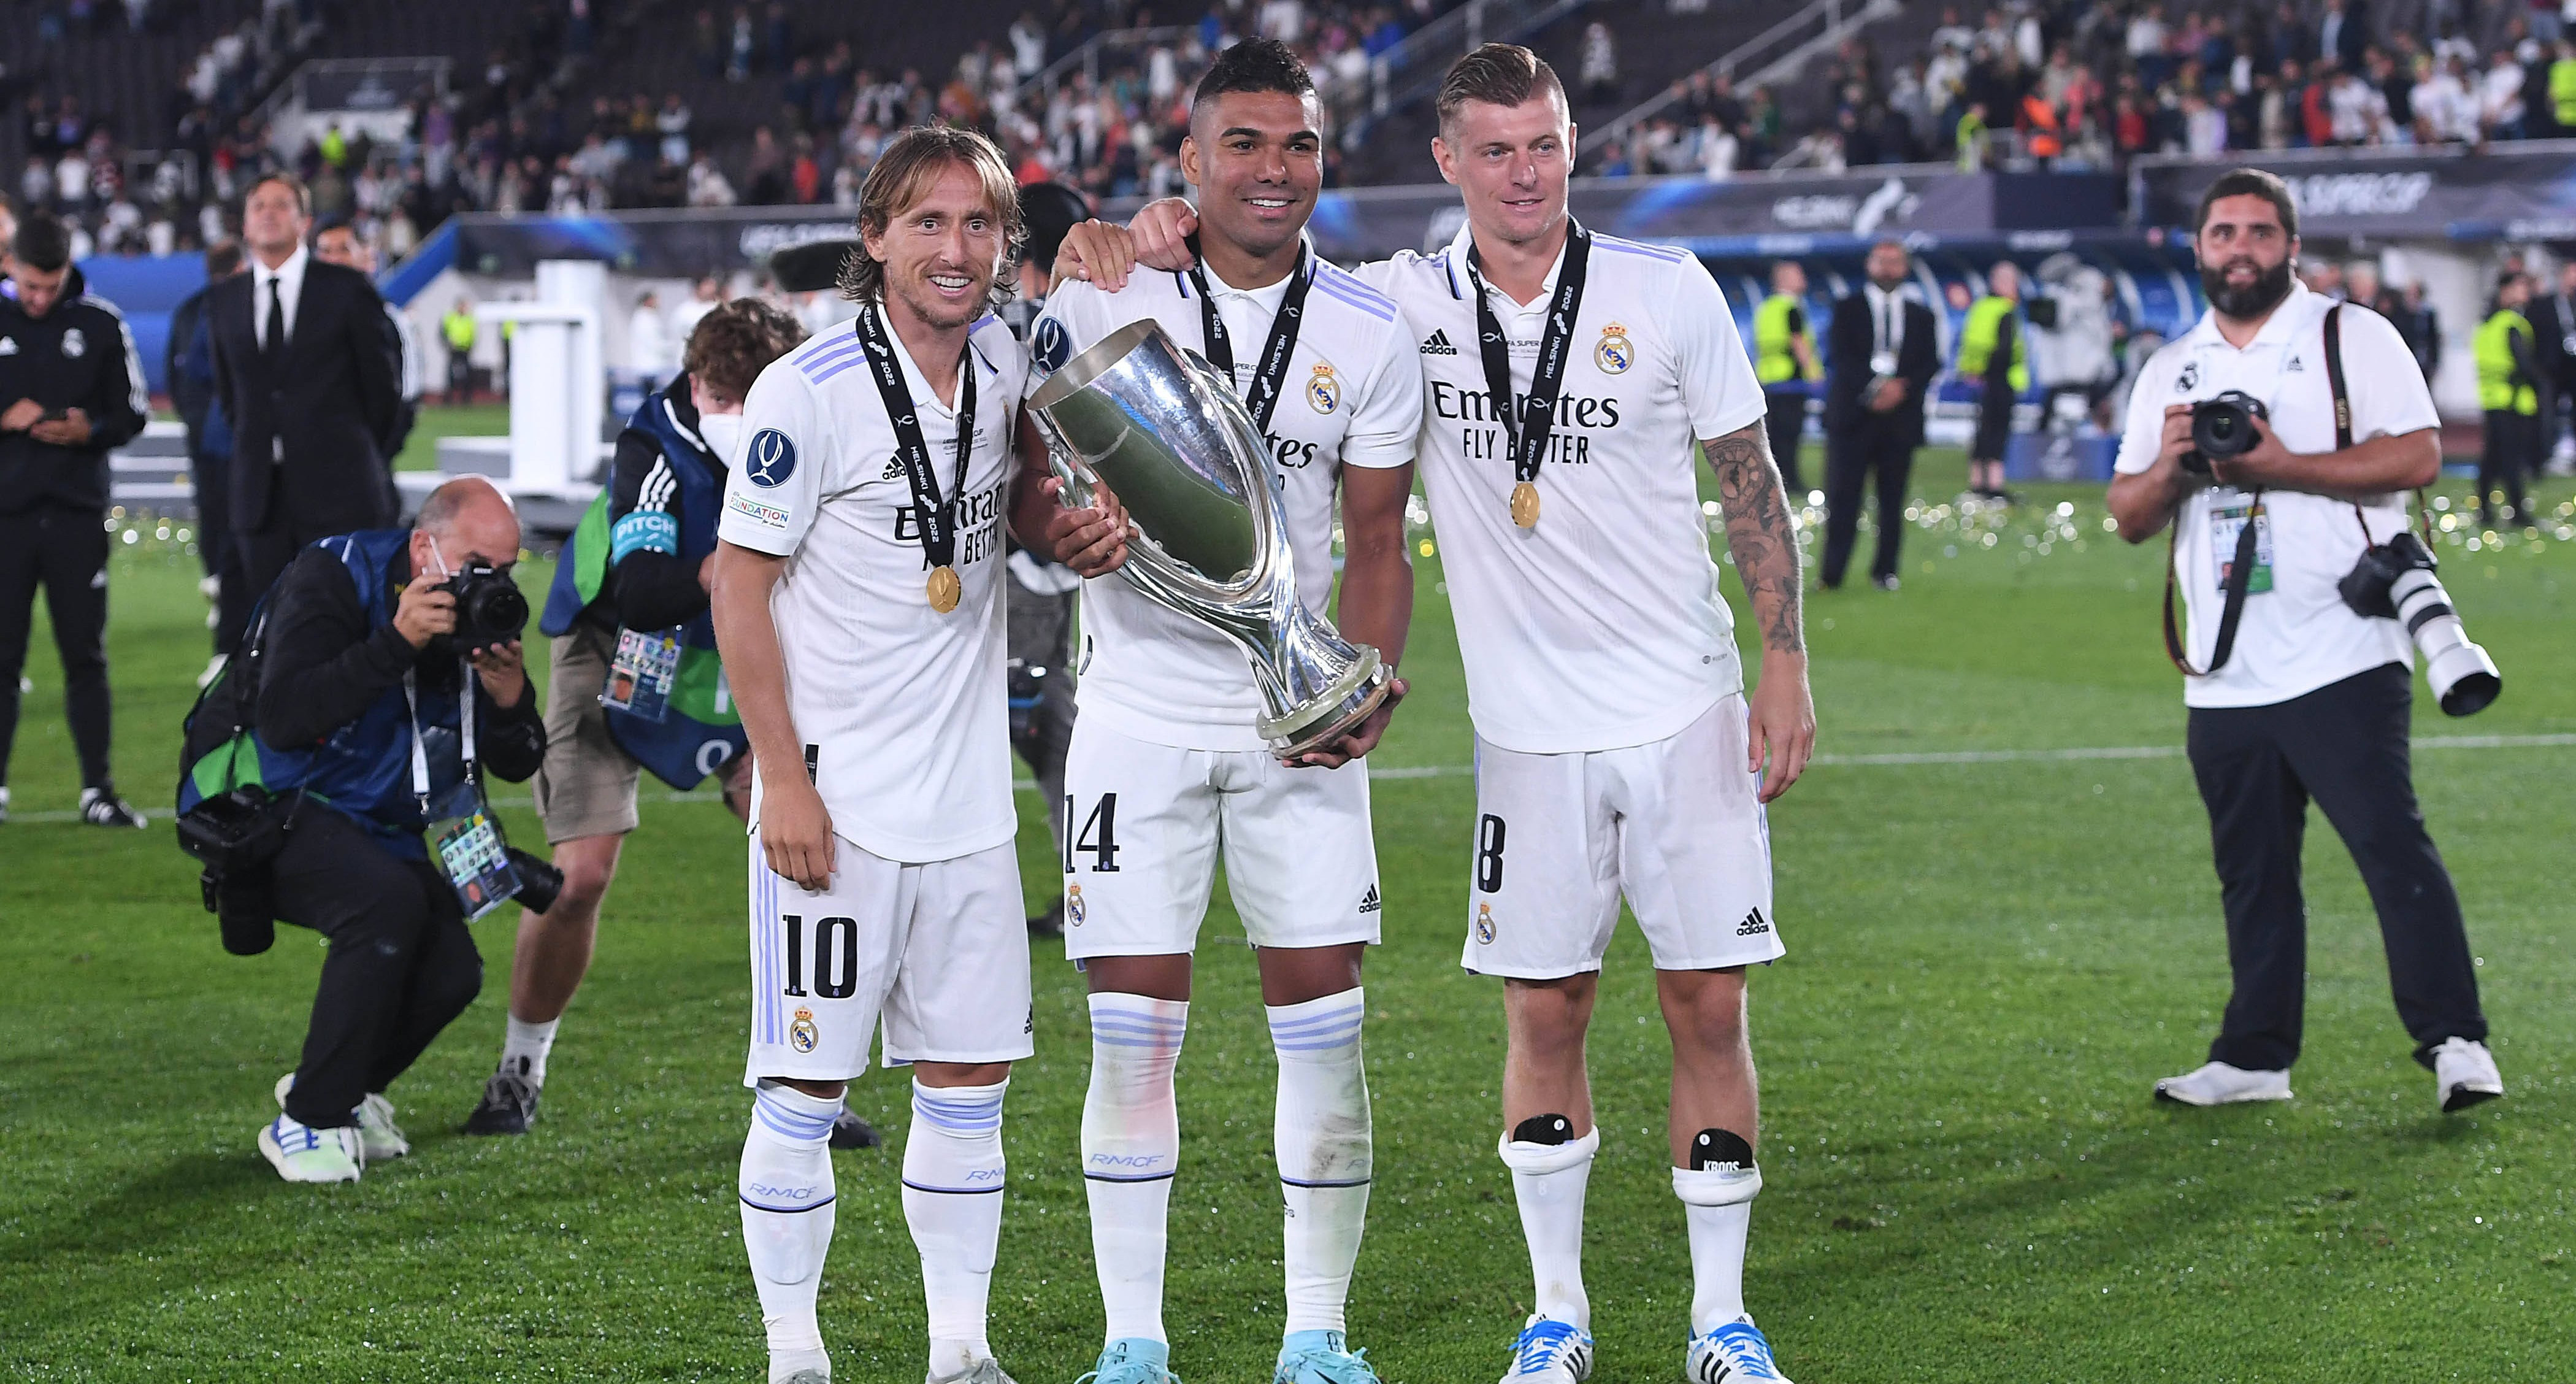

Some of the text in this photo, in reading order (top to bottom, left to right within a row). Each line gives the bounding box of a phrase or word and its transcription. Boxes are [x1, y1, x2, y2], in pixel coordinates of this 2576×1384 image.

[1562, 285, 1573, 310] 2022
[1213, 313, 1222, 339] 2022
[1267, 334, 1287, 375] HELSINKI
[1420, 344, 1457, 355] adidas
[1544, 336, 1562, 379] HELSINKI
[880, 361, 895, 386] 2022
[1431, 381, 1619, 428] Emrtes
[1463, 428, 1589, 464] FLY BTER
[1527, 439, 1537, 465] 2022
[882, 464, 907, 480] adid
[910, 446, 929, 490] HELSINKI
[616, 516, 675, 540] PITCH
[927, 517, 940, 543] 2022
[1065, 793, 1121, 874] 14
[1478, 813, 1506, 893] 8
[1736, 923, 1769, 936] adidas
[783, 914, 857, 998] 10
[1090, 1153, 1164, 1167] RMCF
[965, 1166, 1004, 1181] RM
[749, 1182, 817, 1199] RMCF
